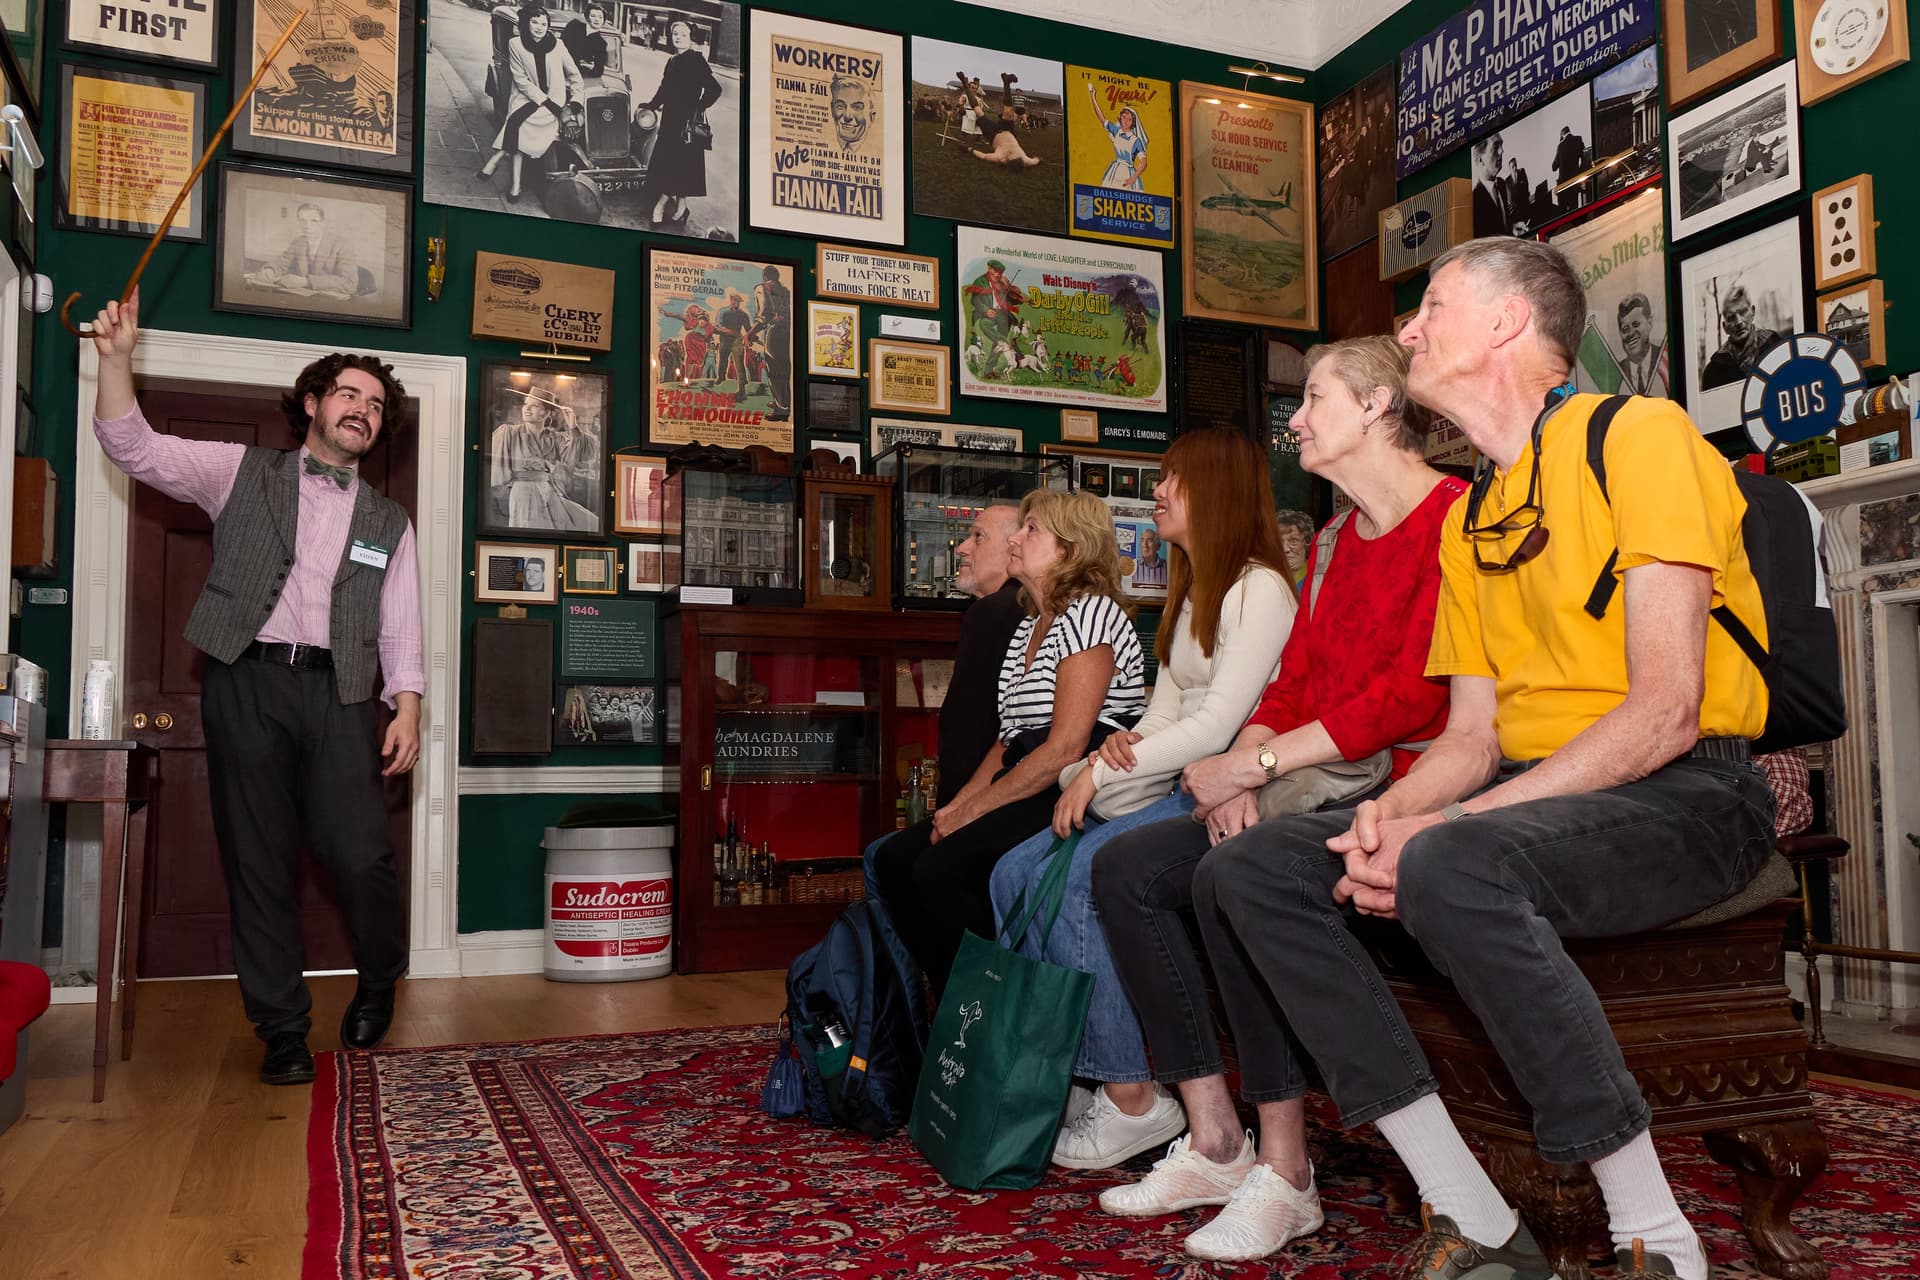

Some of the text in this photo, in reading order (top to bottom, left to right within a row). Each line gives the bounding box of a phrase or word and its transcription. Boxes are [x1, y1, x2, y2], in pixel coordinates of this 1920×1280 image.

[99, 4, 187, 41] FIRST
[1552, 3, 1640, 68] DUBLIN.
[314, 54, 347, 64] CRISIS
[774, 42, 881, 86] WORKERS!
[1432, 70, 1471, 112] GAME
[1485, 22, 1549, 82] POULTRY
[1552, 0, 1620, 41] MERCHA
[776, 78, 829, 97] FIANNA FÁIL
[1081, 72, 1150, 90] IT MIGHT BE
[1105, 84, 1158, 110] Yours!
[132, 107, 177, 122] EDWARDS
[257, 102, 372, 128] Skipper for this storm too
[1217, 110, 1274, 132] Prescotts
[1404, 147, 1433, 169] Phone
[1435, 126, 1466, 151] Orders
[1508, 74, 1555, 112] Special
[253, 114, 393, 147] EAMON DE VALERA
[126, 143, 144, 152] AND
[169, 150, 188, 158] MAN
[1211, 129, 1288, 153] SIX HOUR SERVICE
[775, 145, 810, 172] Vote
[810, 148, 839, 160] FIANNA
[860, 156, 868, 164] IS
[870, 157, 881, 166] ON
[1211, 156, 1259, 176] CLEANING
[811, 159, 826, 169] YOUR
[868, 167, 881, 176] WAS
[810, 169, 880, 186] AND ALWAYS WILL BE
[775, 176, 840, 212] FIANNA
[1093, 188, 1153, 204] BALLSBRIDGE
[1093, 197, 1155, 223] SHARES
[1102, 218, 1146, 230] SERVICE
[825, 251, 931, 273] STUFF YOUR TURKEY AND FOWL
[996, 246, 1022, 257] Wonderful
[1022, 249, 1037, 259] World
[1037, 252, 1043, 260] of
[1058, 254, 1086, 266] LAUGHTER
[1097, 259, 1138, 272] LEPRECHAUNS!
[672, 266, 705, 277] WAYNE
[847, 267, 911, 285] HAFNER'S
[674, 283, 725, 296] FITZGERALD
[682, 276, 718, 287] O'HARA
[826, 278, 931, 303] Famous FORCE MEAT
[1042, 273, 1098, 292] Walt Disney's
[1028, 285, 1073, 312] Darby
[544, 304, 603, 323] CLERY
[544, 330, 599, 344] DUBLIN
[1279, 404, 1298, 412] THIS
[1778, 380, 1827, 423] BUS
[656, 403, 764, 425] TRANQUILLE
[1271, 410, 1293, 419] WIND
[723, 432, 741, 440] JOHN
[1132, 430, 1167, 441] LEMONADE
[1453, 444, 1469, 456] CLUB
[569, 605, 600, 616] 1940s
[735, 732, 835, 743] MAGDALENE
[716, 746, 799, 757] AUNDRIES
[565, 882, 668, 907] Sudocrem
[570, 911, 617, 919] ANTISEPTIC
[623, 909, 655, 918] HEALING
